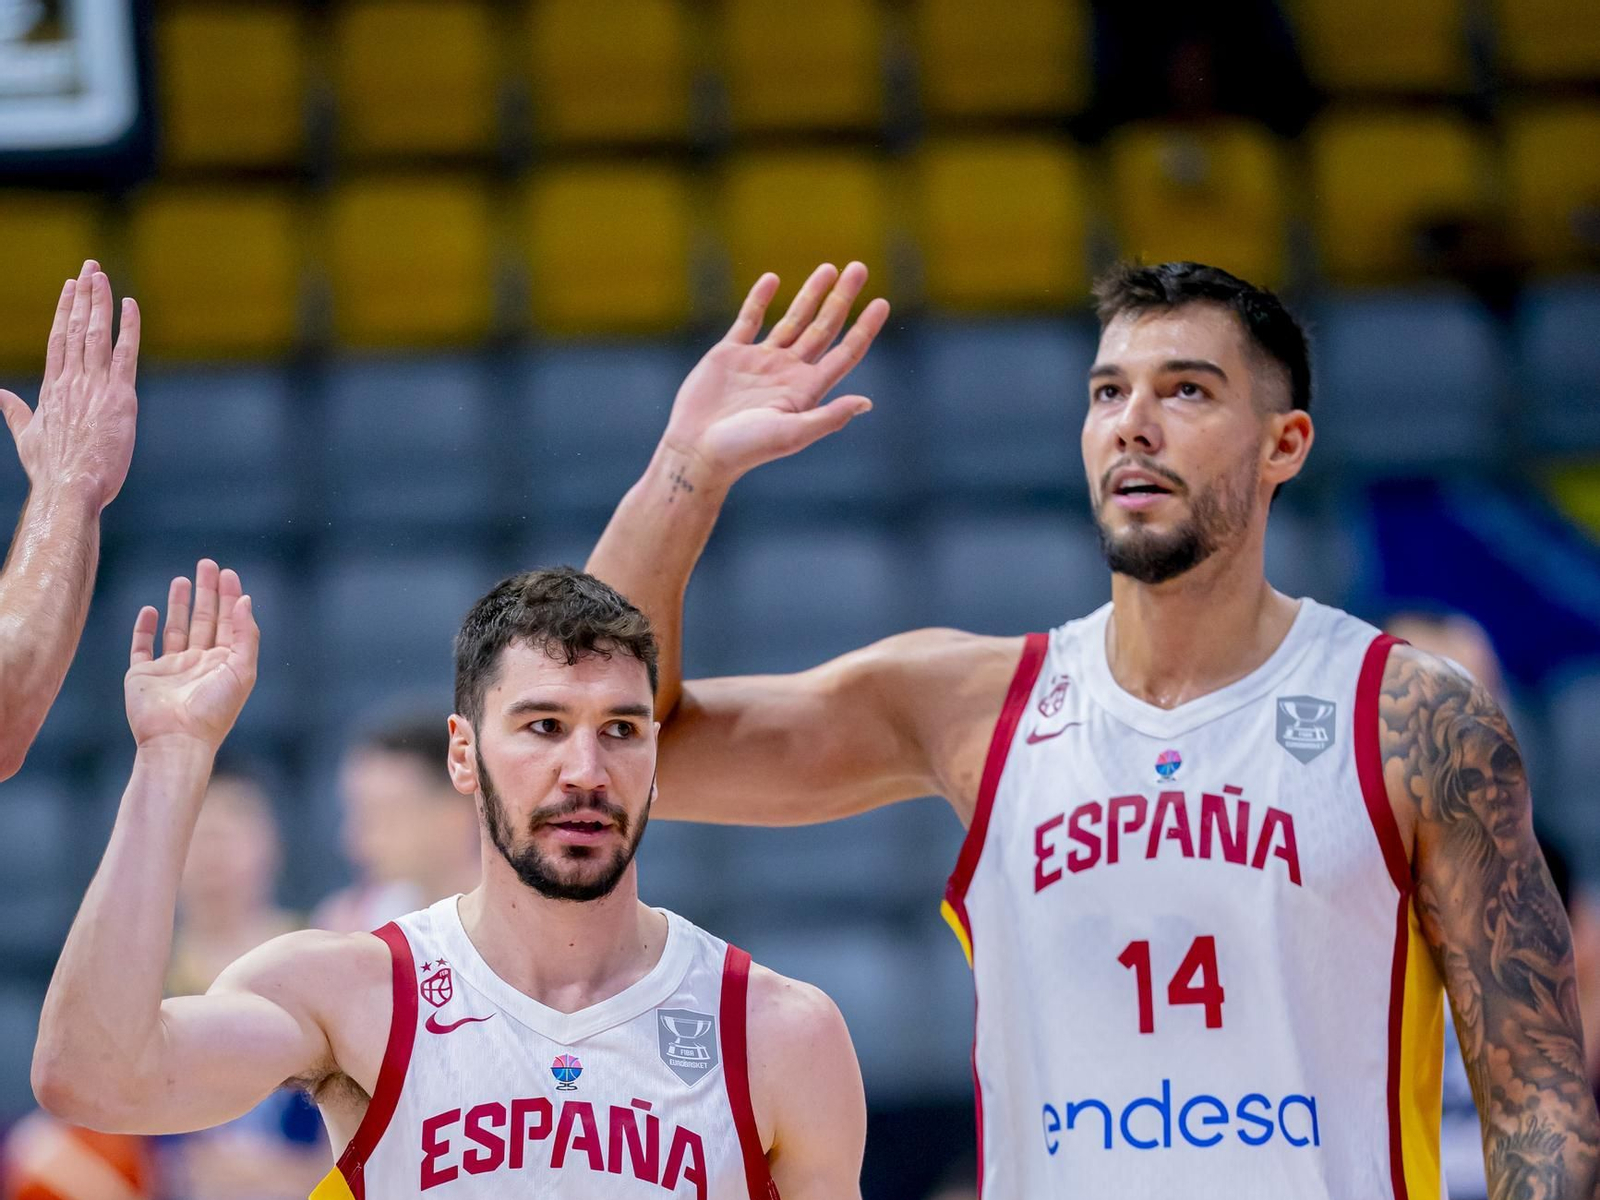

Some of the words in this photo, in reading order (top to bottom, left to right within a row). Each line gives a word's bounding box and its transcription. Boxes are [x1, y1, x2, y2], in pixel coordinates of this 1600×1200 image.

[1034, 785, 1302, 893] ESPAÑA
[1117, 935, 1225, 1034] 14
[669, 1058, 708, 1069] EUROBASKET
[1042, 1078, 1321, 1156] endesa
